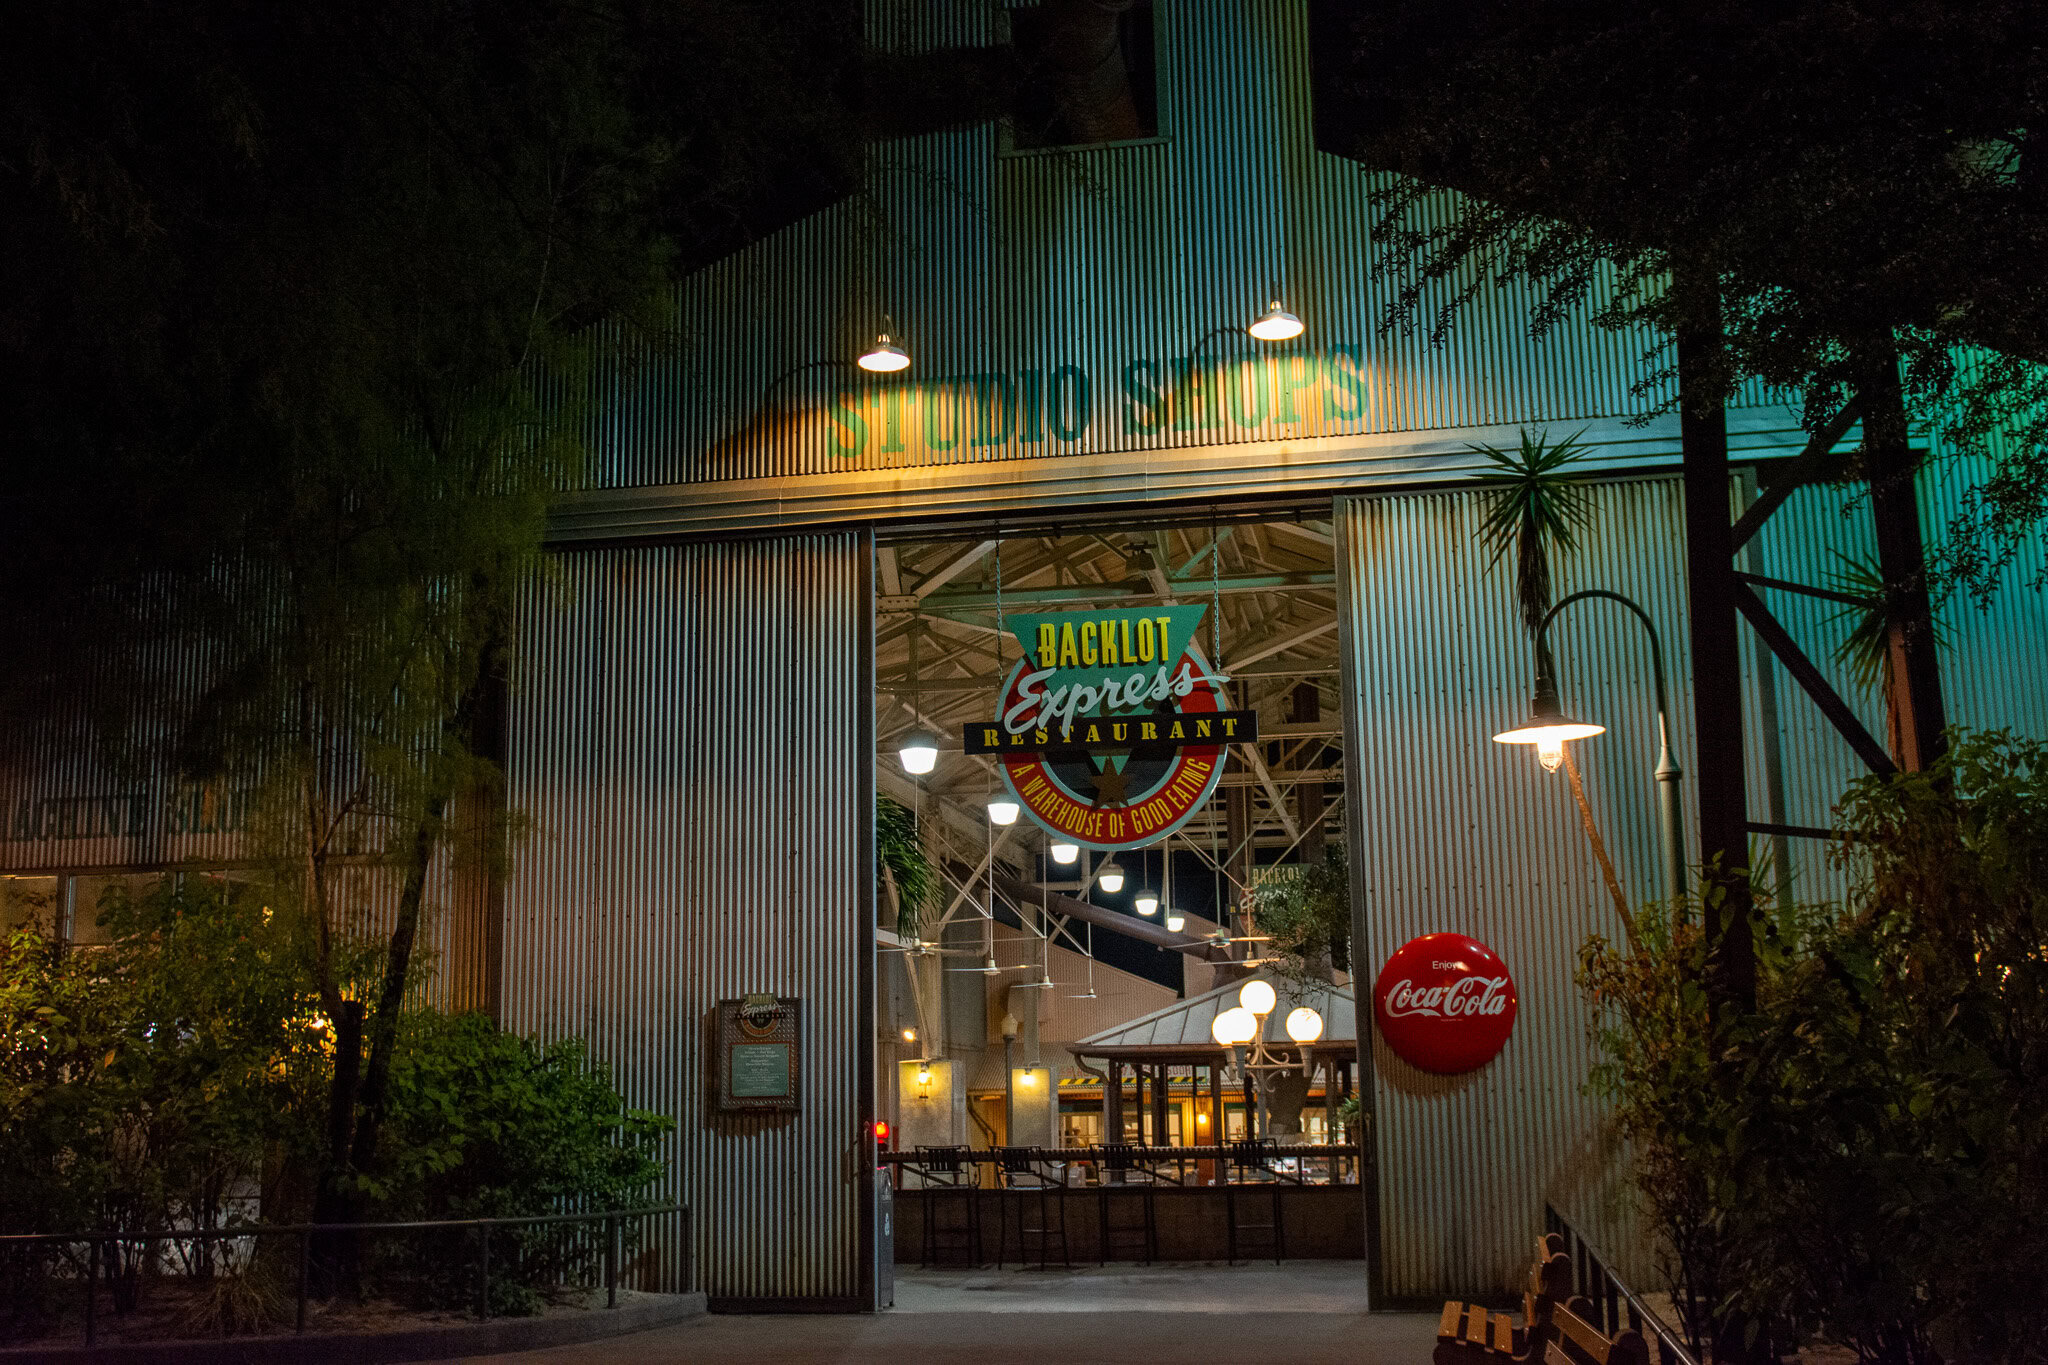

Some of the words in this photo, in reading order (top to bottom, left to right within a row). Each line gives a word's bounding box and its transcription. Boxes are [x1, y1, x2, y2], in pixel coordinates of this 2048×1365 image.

[826, 364, 1090, 460] STUDIO
[1123, 343, 1369, 437] SHOPS
[1037, 616, 1172, 668] BACKLOT
[1004, 662, 1231, 738] Express
[983, 718, 1238, 748] RESTAURANT
[1012, 763, 1028, 779] A
[1022, 778, 1103, 838] WAREHOUSE
[1108, 813, 1126, 839] OF
[1131, 788, 1172, 835] GOOD
[1164, 757, 1211, 811] EATING
[1432, 960, 1457, 971] Enjoy
[1385, 976, 1508, 1018] Coca-Cola
